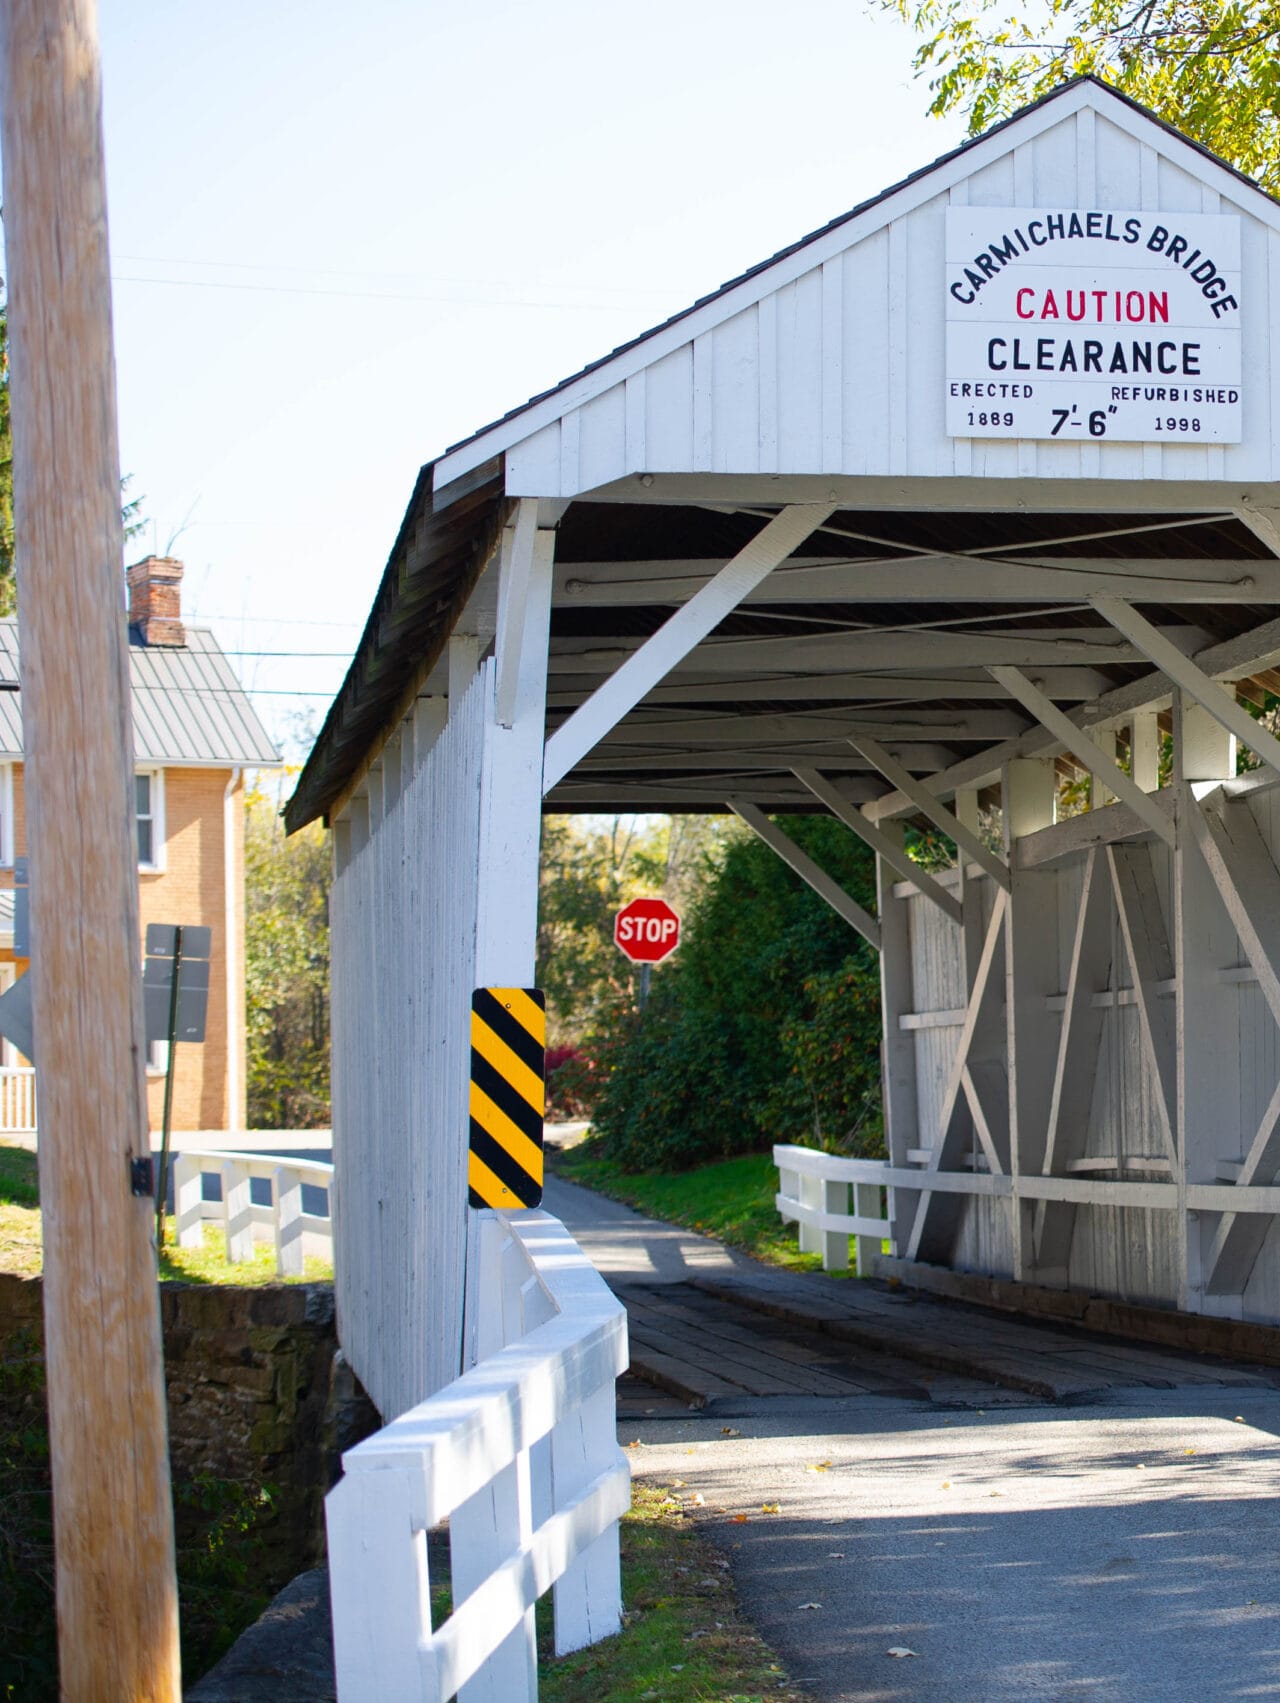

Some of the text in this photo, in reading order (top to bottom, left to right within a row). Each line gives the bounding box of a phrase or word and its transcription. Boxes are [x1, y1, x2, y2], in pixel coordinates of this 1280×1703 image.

[950, 212, 1238, 319] CARMICHAELS BRIDGE
[1016, 287, 1169, 323] CAUTION
[987, 338, 1201, 375] CLEARANCE
[950, 383, 1033, 398] ERECTED
[1111, 386, 1239, 404] REFURBISHED
[967, 412, 1014, 426] 1889
[1155, 417, 1201, 432] 1998
[619, 916, 676, 943] STOP
